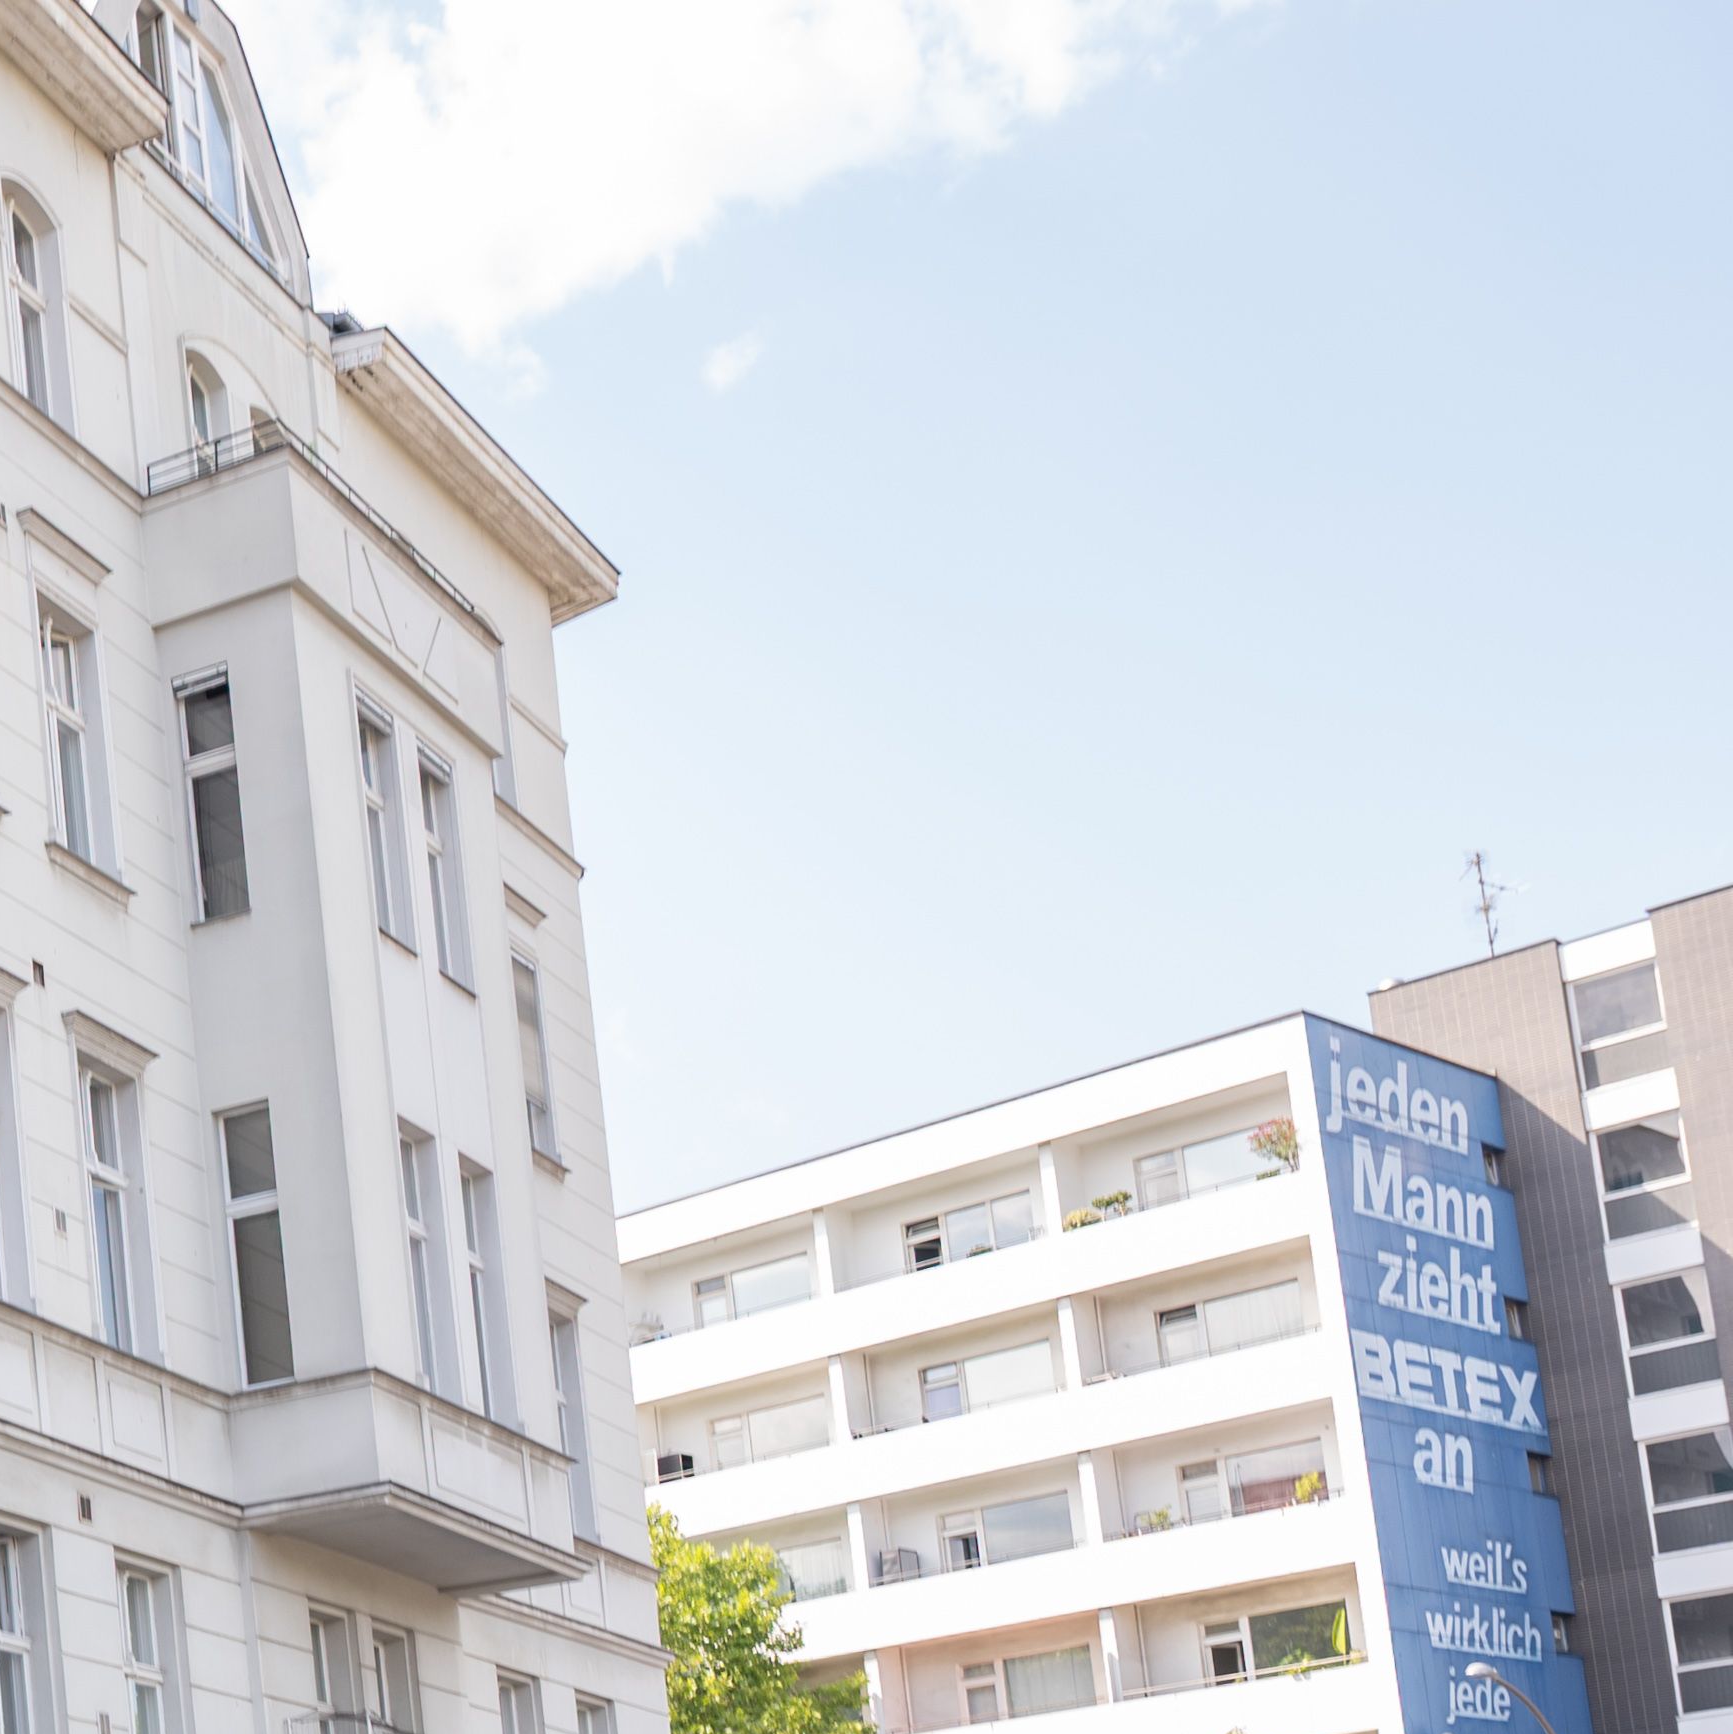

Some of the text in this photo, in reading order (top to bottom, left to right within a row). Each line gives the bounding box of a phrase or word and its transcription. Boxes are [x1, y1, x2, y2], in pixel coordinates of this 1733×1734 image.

[1326, 1038, 1468, 1155] jeden
[1353, 1134, 1494, 1250] Mann
[1378, 1234, 1501, 1335] zieht
[1351, 1328, 1548, 1436] BETEX
[1413, 1427, 1474, 1494] an
[1441, 1540, 1528, 1595] weil's
[1425, 1601, 1542, 1662] wirklich
[1447, 1666, 1511, 1725] jede
